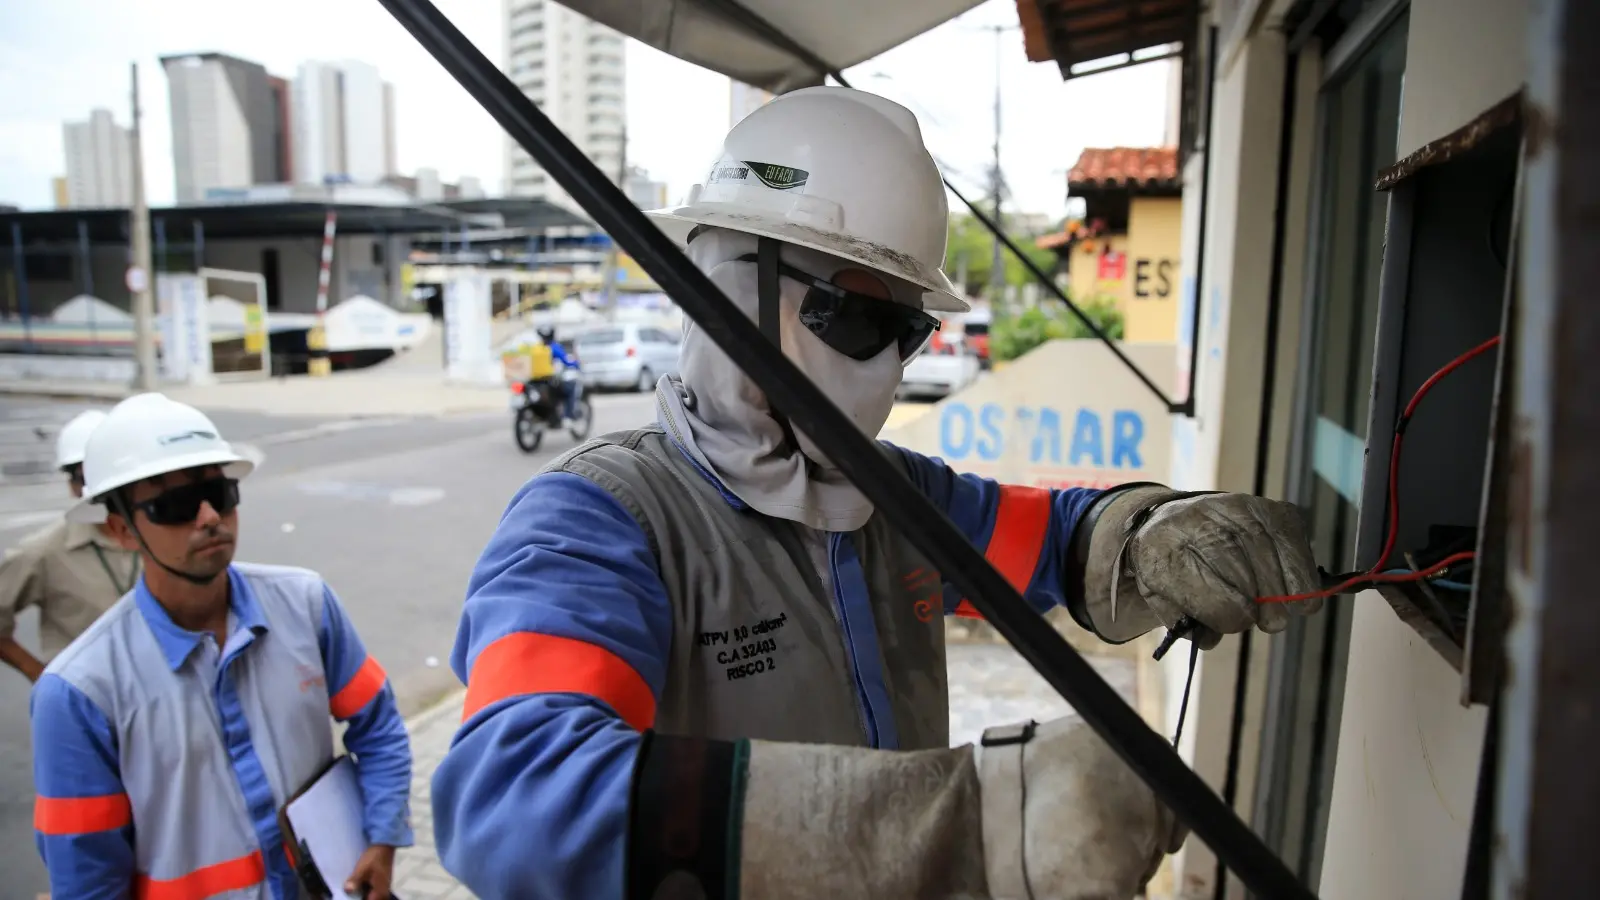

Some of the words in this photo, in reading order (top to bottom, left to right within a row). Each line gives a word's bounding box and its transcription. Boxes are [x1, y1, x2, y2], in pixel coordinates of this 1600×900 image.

[765, 165, 776, 179] EU
[698, 631, 729, 646] ATPV
[727, 660, 765, 680] RISCO
[766, 657, 776, 670] 2
